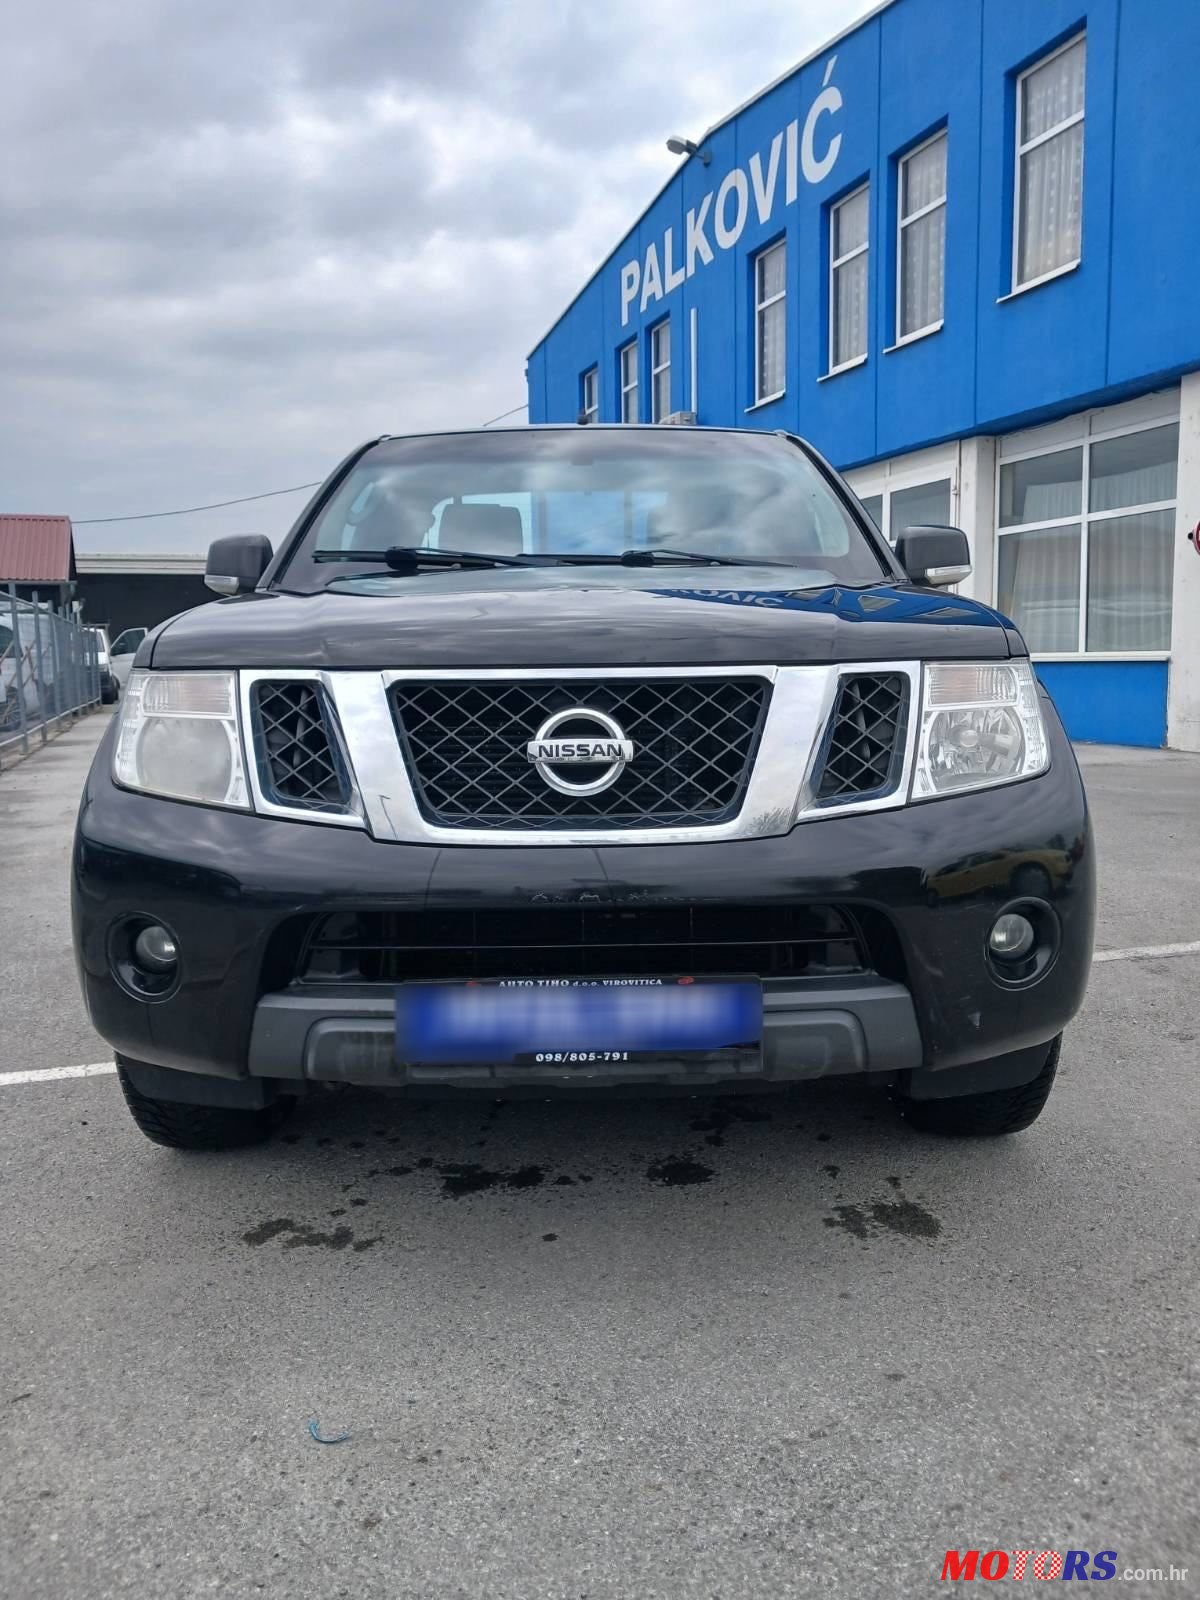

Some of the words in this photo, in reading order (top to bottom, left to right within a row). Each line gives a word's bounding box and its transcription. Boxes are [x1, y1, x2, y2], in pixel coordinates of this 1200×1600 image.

[621, 55, 843, 327] PALKOVIĆ
[538, 743, 622, 758] NISSAN
[499, 980, 534, 988] AUTO
[602, 978, 663, 986] VIROVITICA
[535, 1051, 629, 1063] 098/805-791
